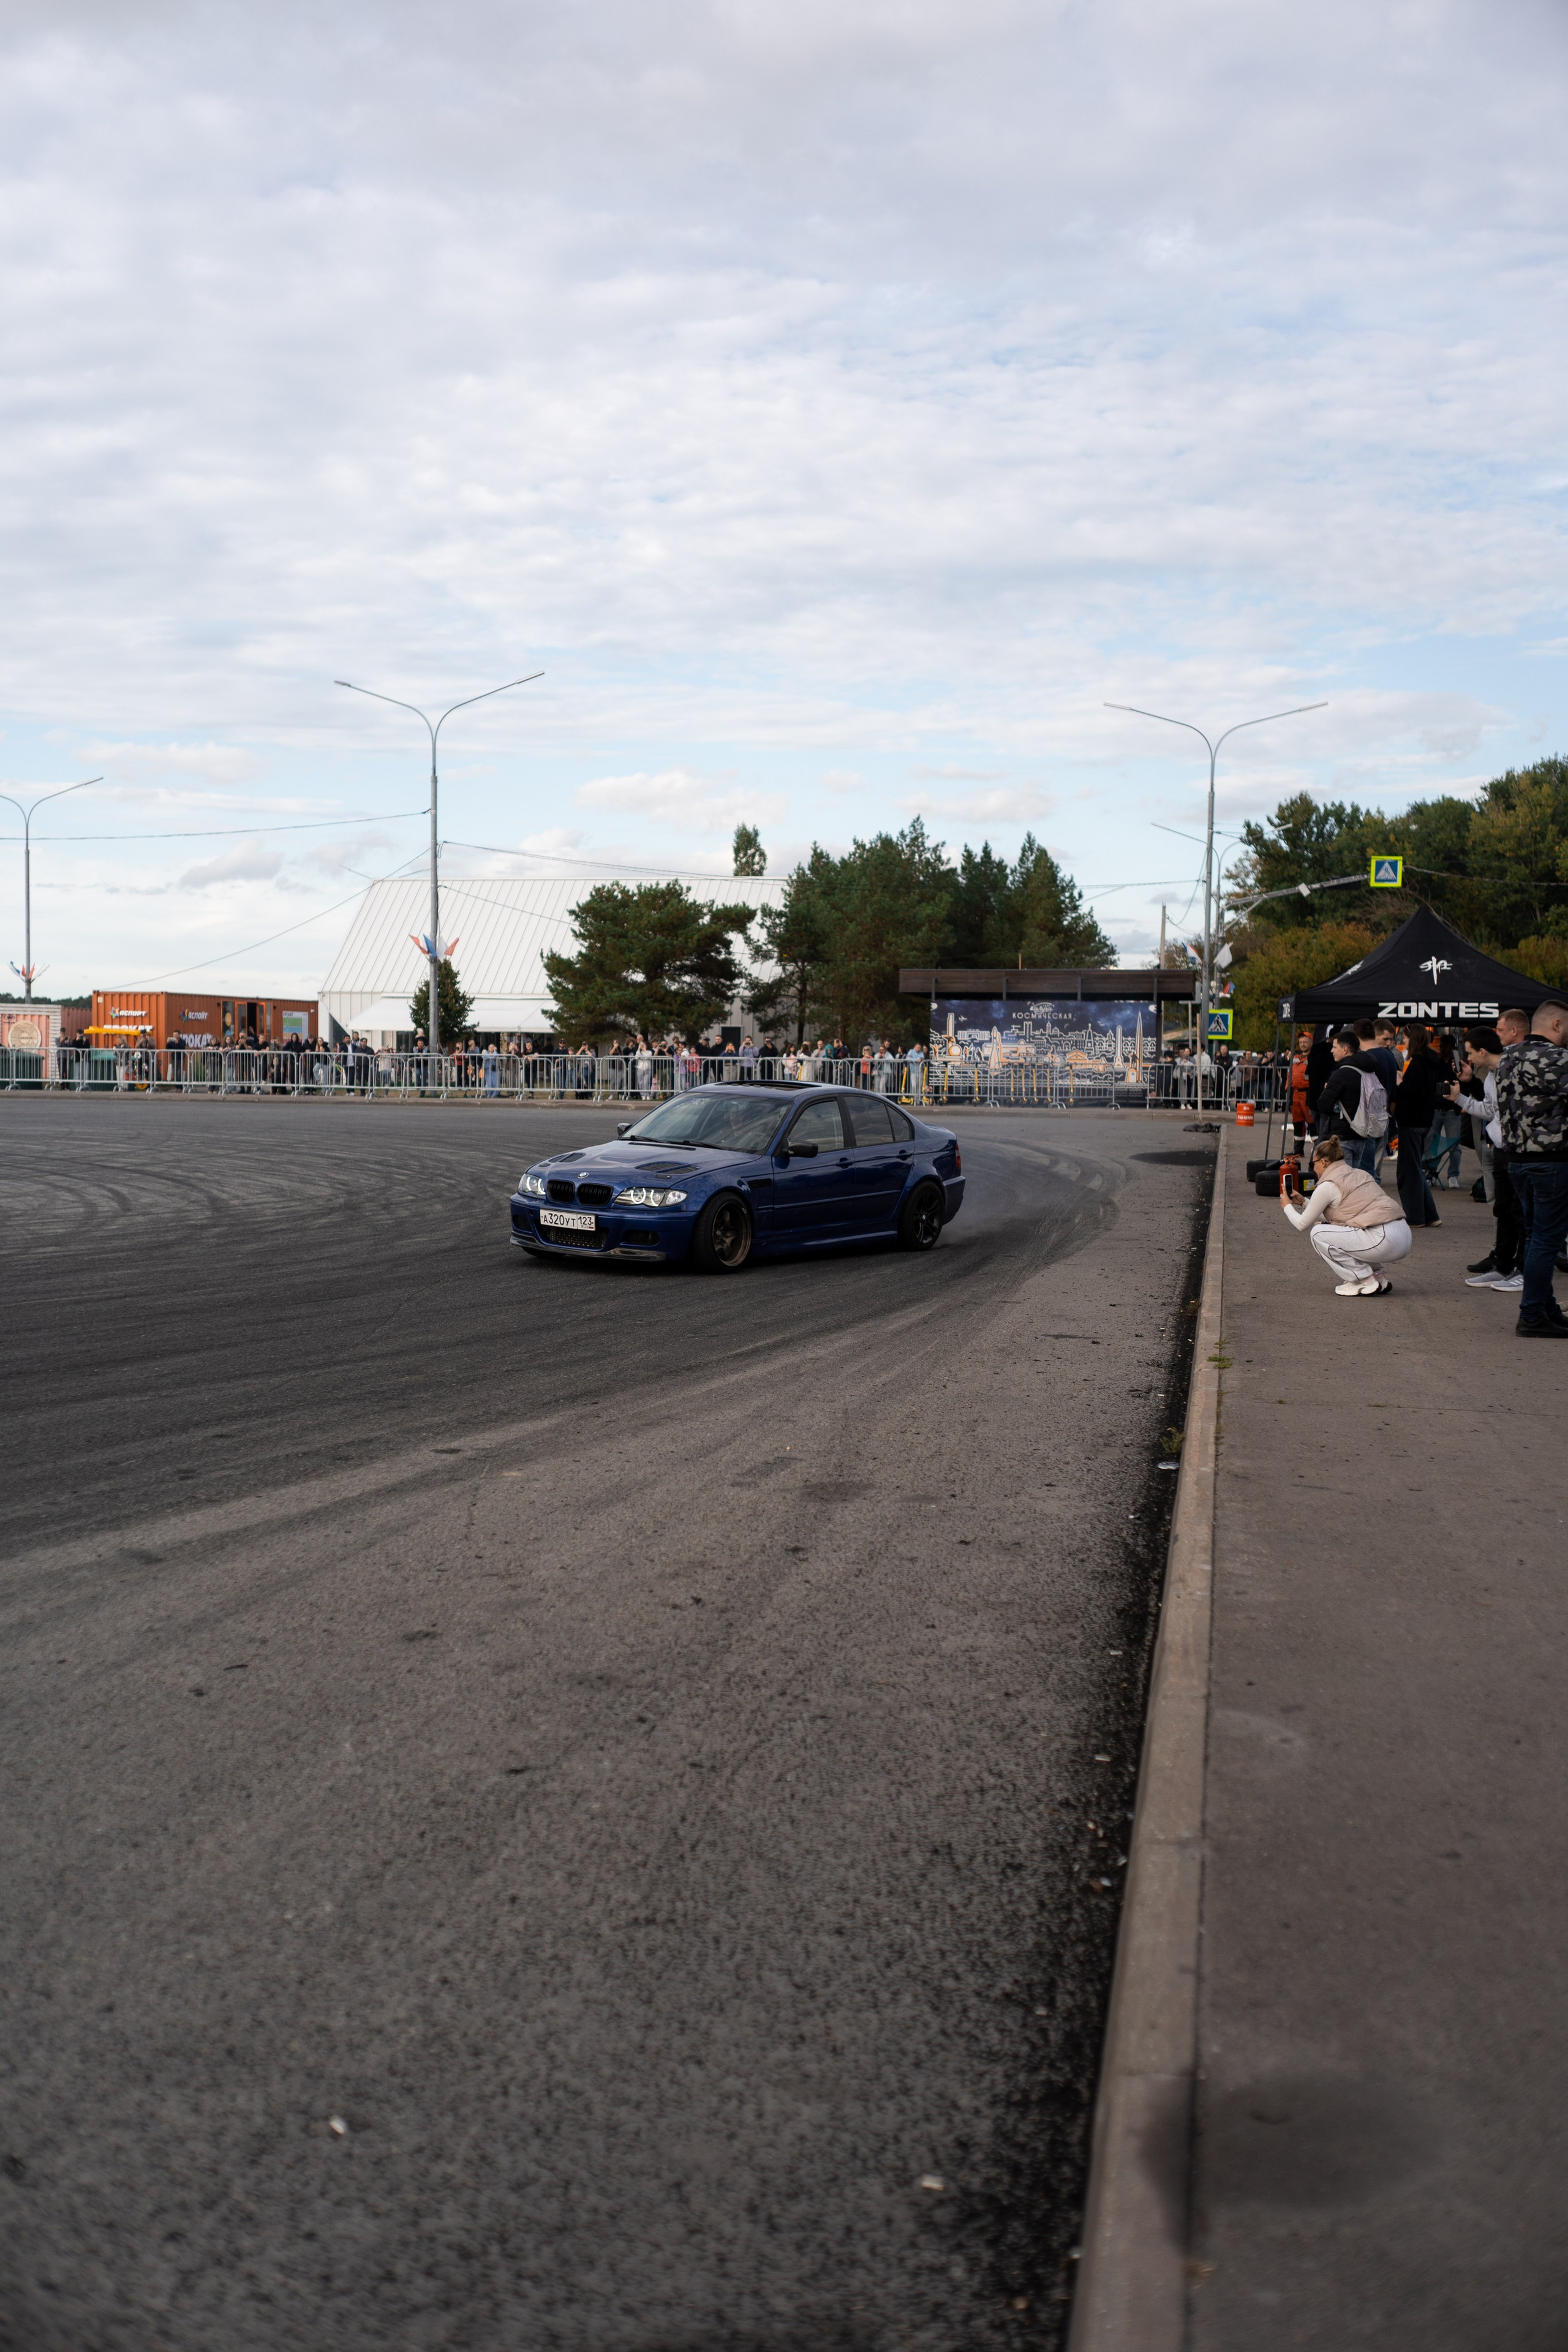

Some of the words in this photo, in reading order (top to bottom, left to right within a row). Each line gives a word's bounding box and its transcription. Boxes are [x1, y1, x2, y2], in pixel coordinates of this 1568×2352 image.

[188, 1011, 208, 1020] ЯСПОРТ
[1378, 1002, 1499, 1018] ZONTES
[179, 1033, 212, 1048] РОКАТ
[543, 1213, 576, 1227] А320УТ
[578, 1216, 592, 1226] 123
